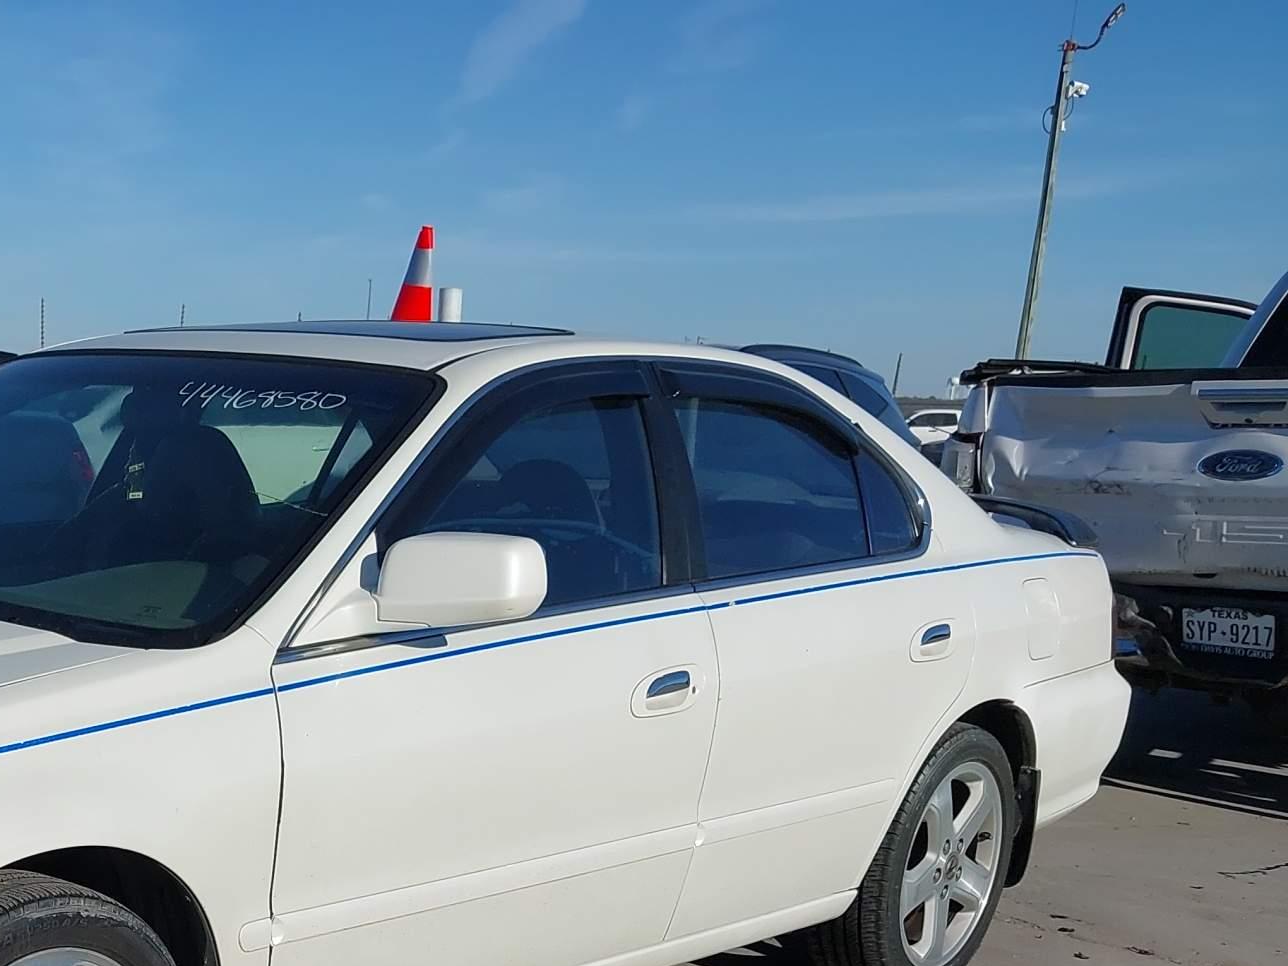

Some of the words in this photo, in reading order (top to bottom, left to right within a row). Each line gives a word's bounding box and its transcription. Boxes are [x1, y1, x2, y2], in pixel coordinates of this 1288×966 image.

[179, 381, 347, 411] 44468580
[1215, 456, 1263, 473] Ford
[1211, 608, 1249, 621] TEXAS
